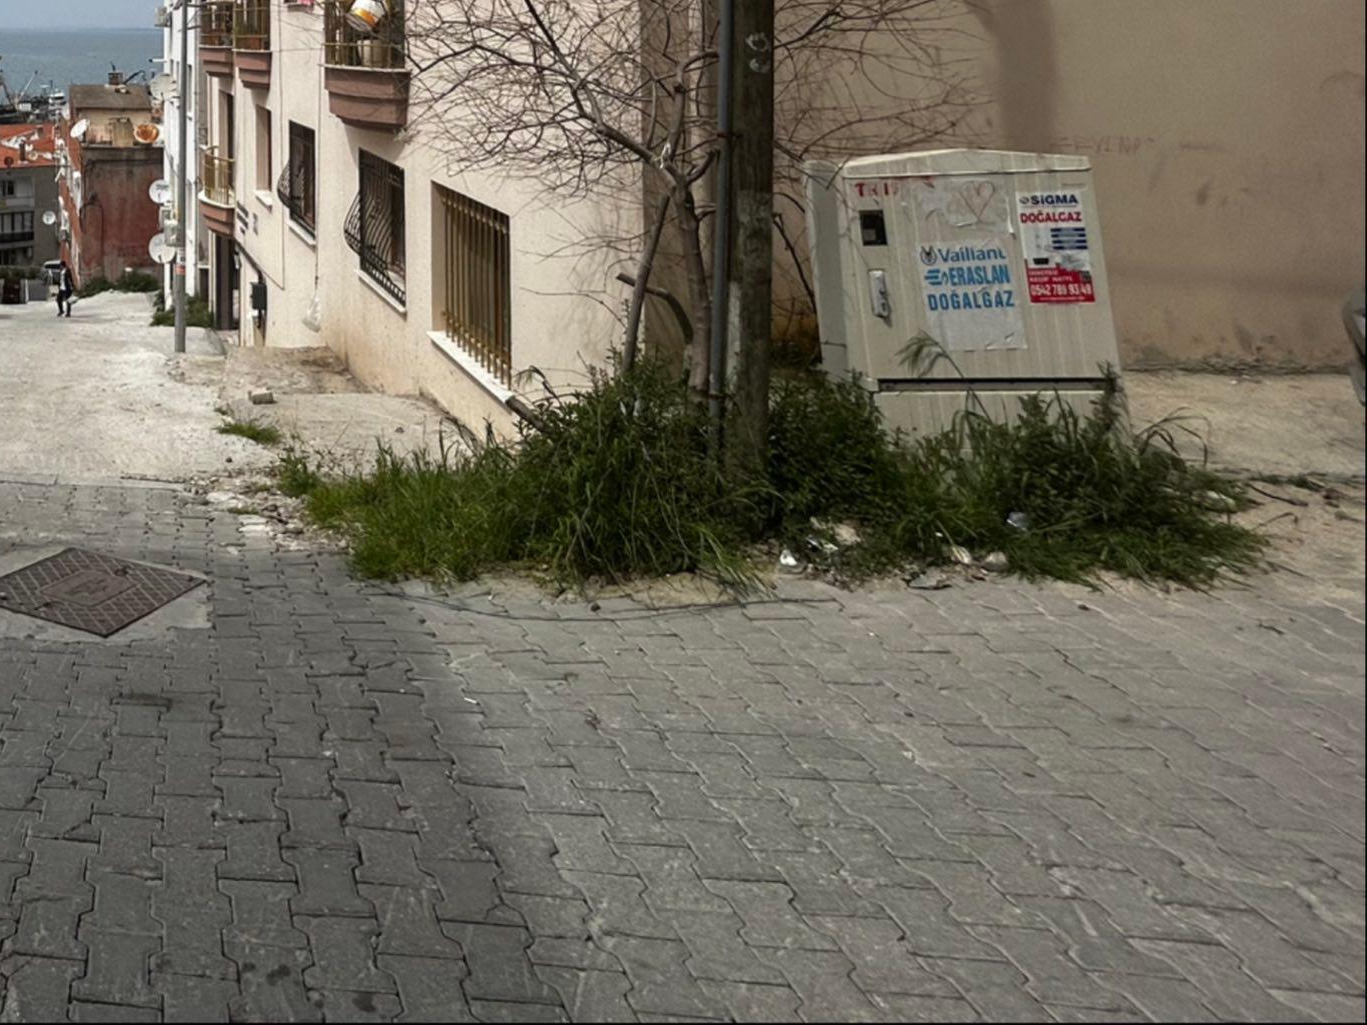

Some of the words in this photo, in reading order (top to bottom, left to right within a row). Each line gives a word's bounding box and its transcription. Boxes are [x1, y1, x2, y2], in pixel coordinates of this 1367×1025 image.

[937, 246, 1007, 263] Vaillant
[948, 264, 1011, 287] ERASLAN
[927, 290, 1016, 312] DOĞALGAZ
